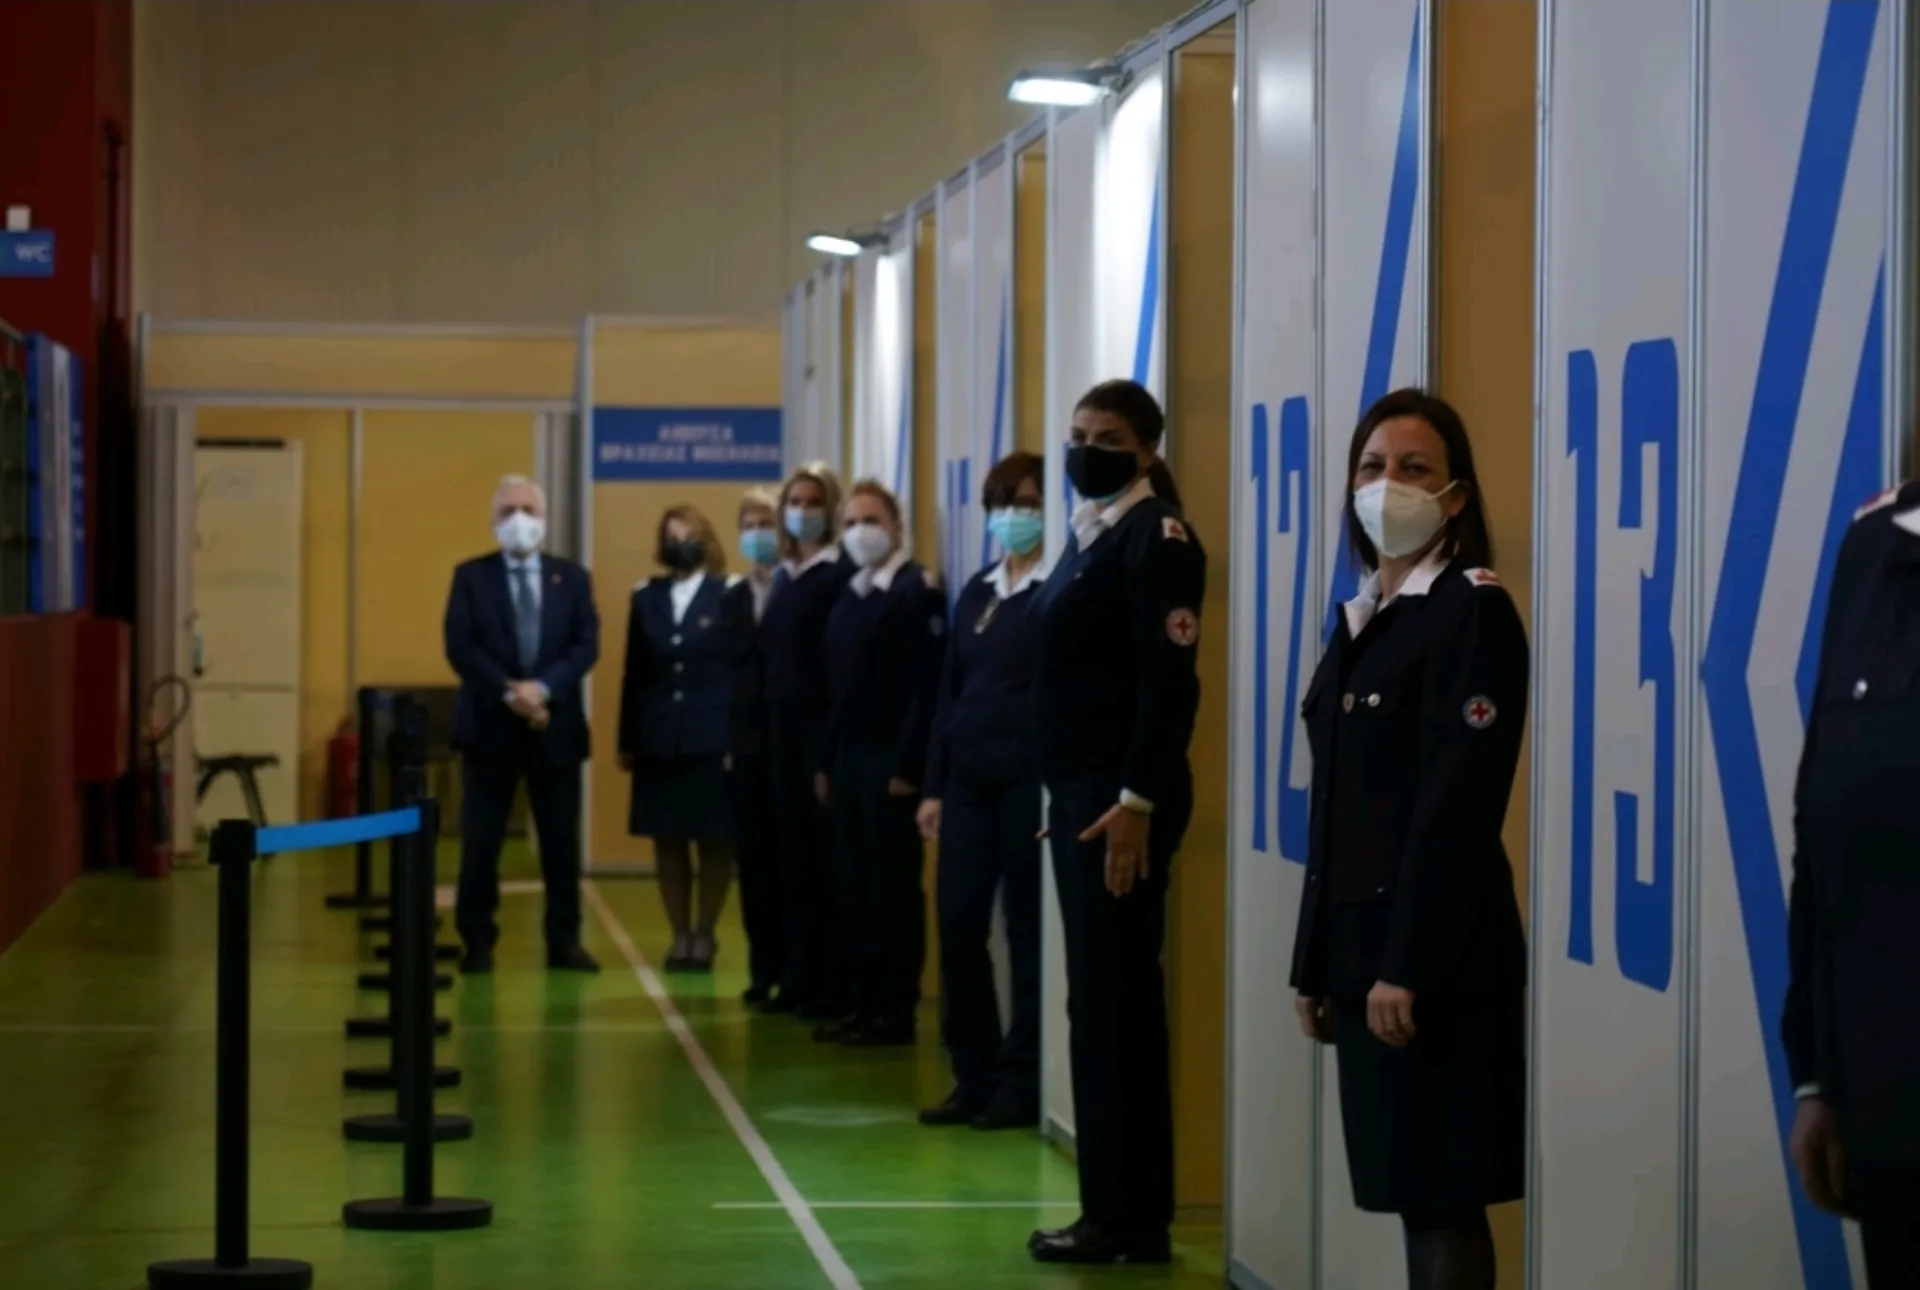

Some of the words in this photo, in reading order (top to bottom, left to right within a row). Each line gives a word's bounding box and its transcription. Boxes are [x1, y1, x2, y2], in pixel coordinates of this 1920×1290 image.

[15, 242, 52, 263] WC
[1251, 395, 1309, 866] 12
[1566, 338, 1679, 992] 13
